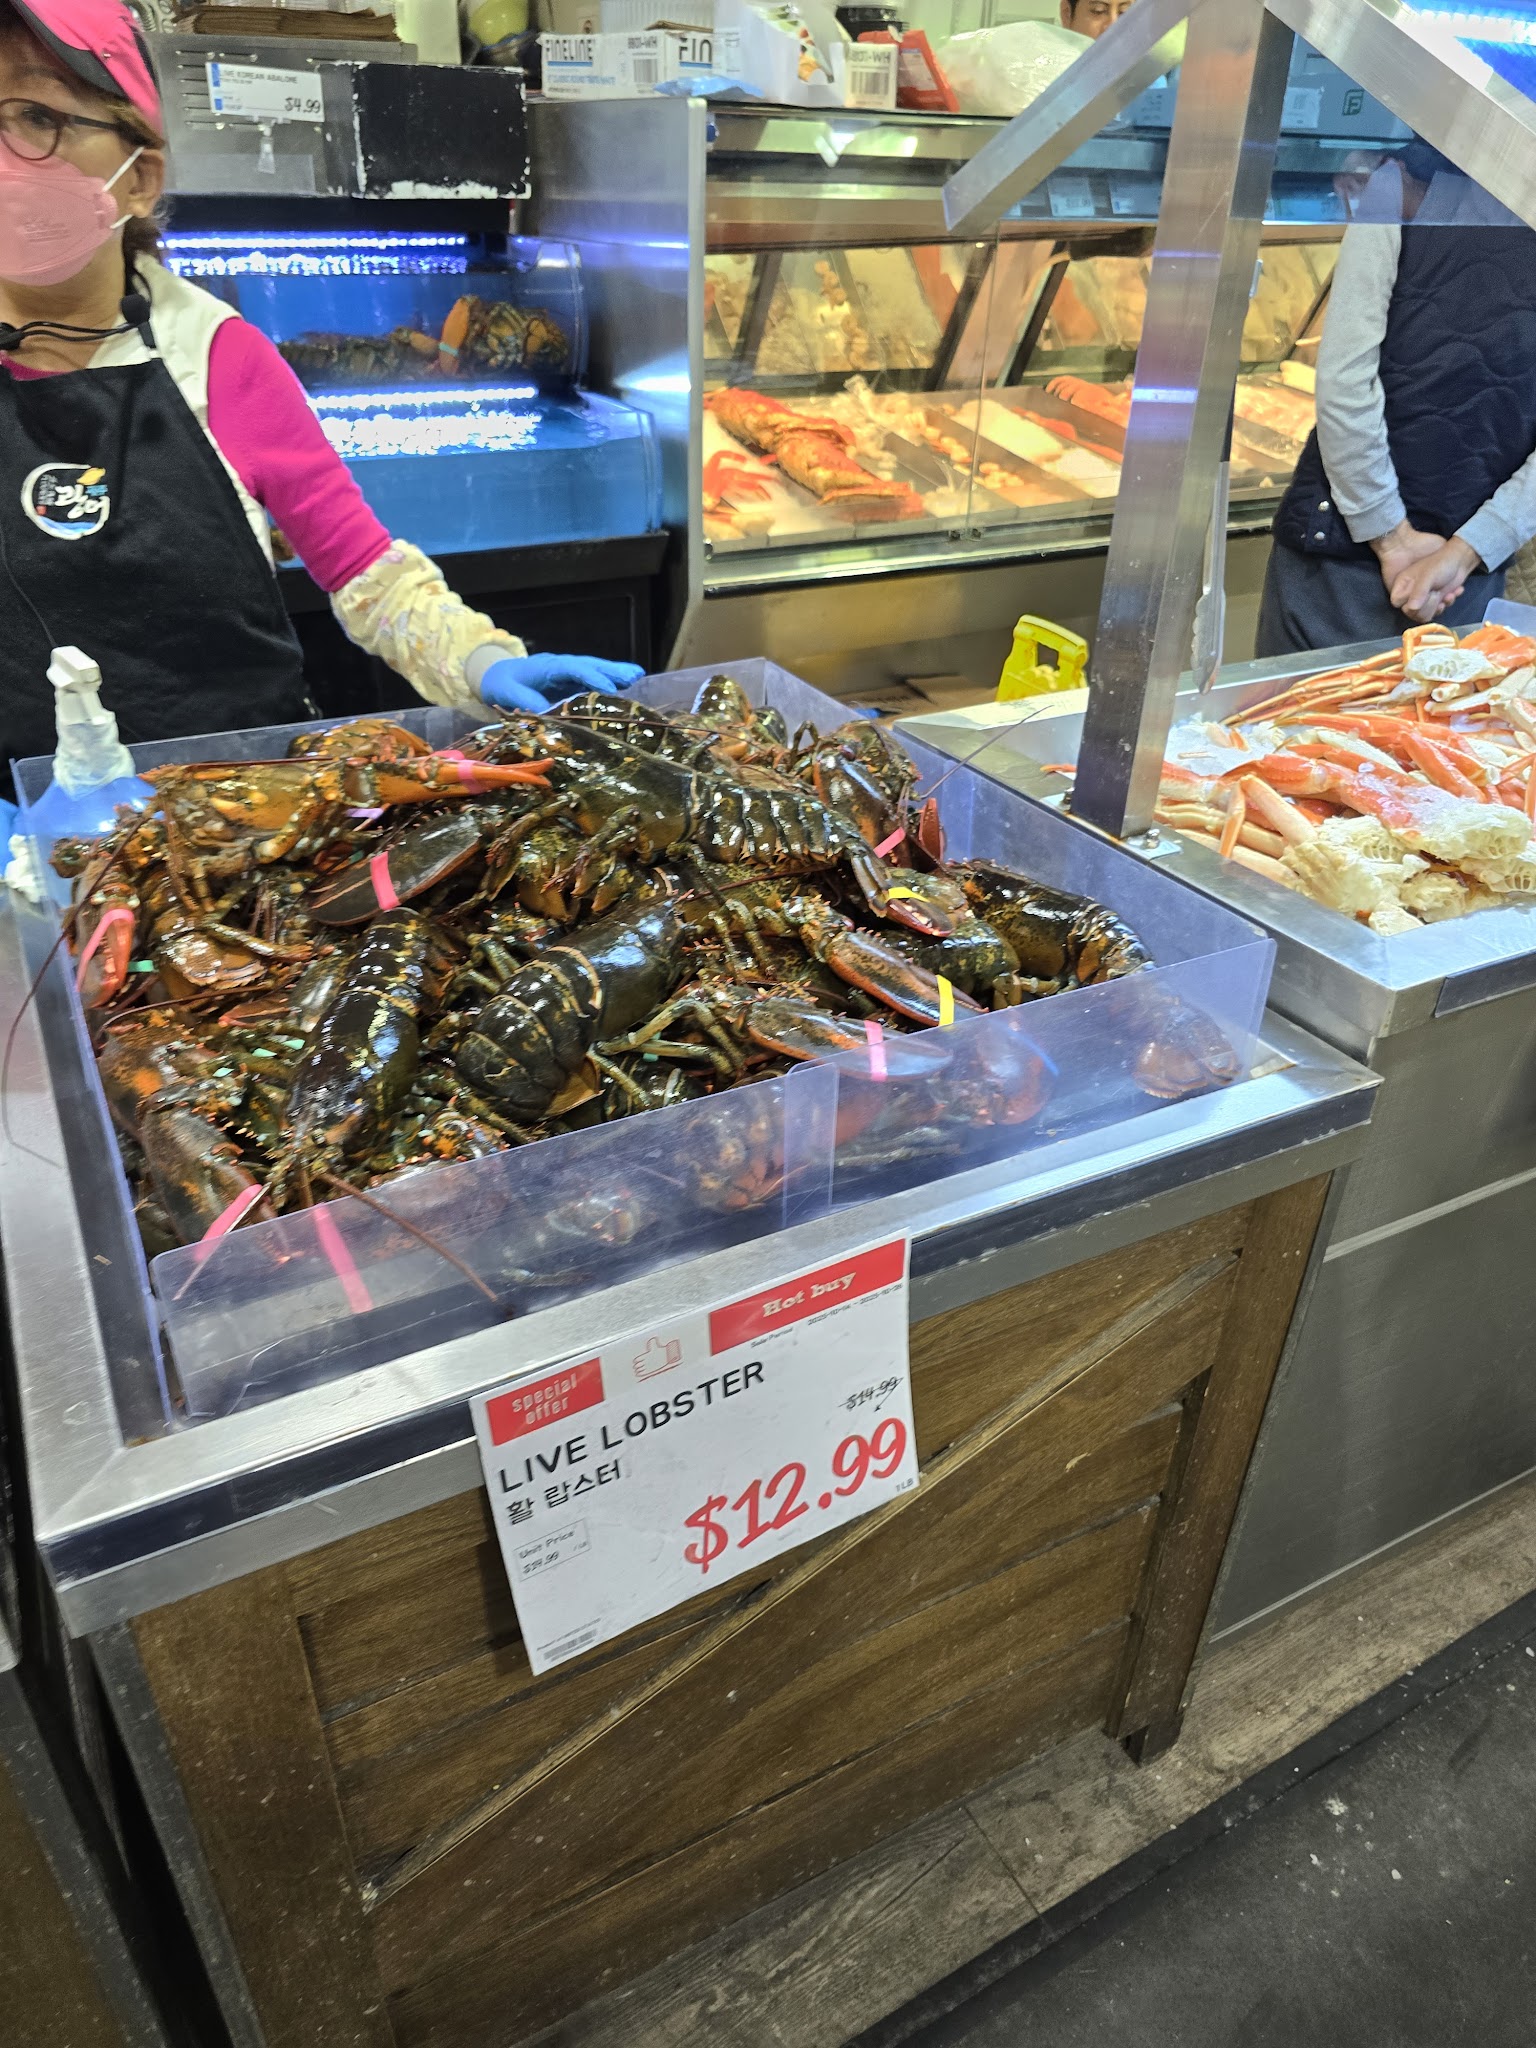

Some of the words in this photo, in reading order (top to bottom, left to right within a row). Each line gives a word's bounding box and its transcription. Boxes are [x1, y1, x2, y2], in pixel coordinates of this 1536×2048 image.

[546, 39, 593, 61] FINELINE
[762, 1290, 806, 1317] Hot
[810, 1272, 857, 1298] buy
[511, 1373, 578, 1413] special
[525, 1397, 569, 1425] offer
[499, 1435, 588, 1493] LIVE
[601, 1361, 764, 1450] LOBSTER
[505, 1497, 535, 1526] 활
[544, 1459, 621, 1509] 랍스터
[684, 1417, 906, 1574] $12.99
[901, 1478, 914, 1489] LB
[519, 1544, 543, 1559] Unit
[545, 1530, 575, 1548] Price
